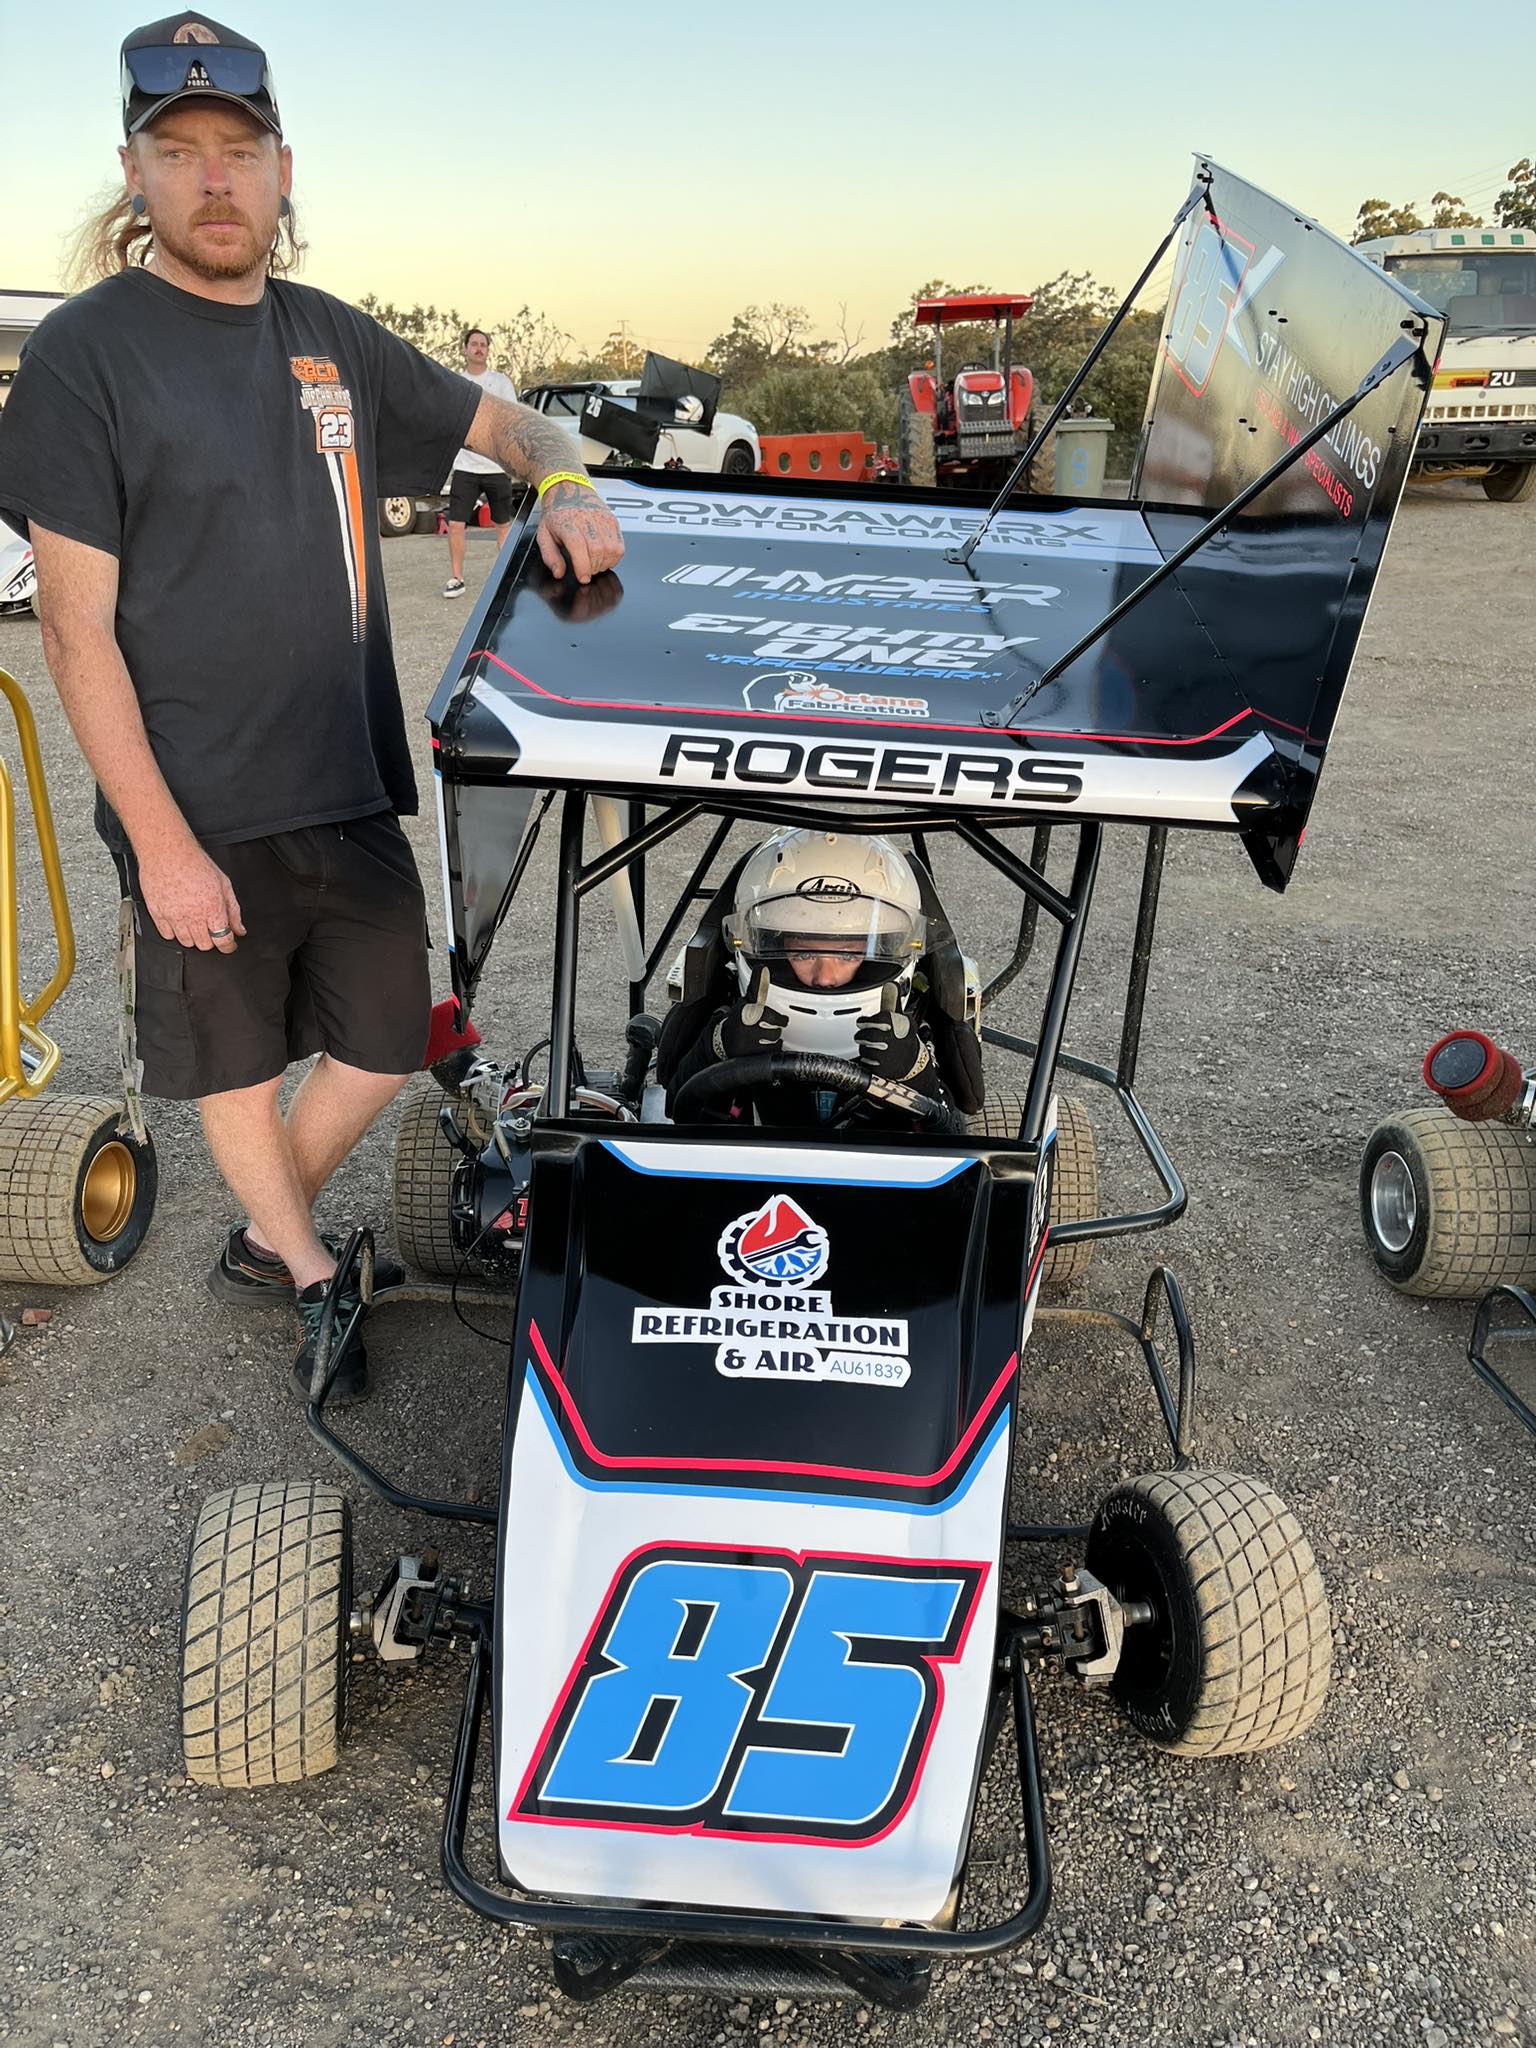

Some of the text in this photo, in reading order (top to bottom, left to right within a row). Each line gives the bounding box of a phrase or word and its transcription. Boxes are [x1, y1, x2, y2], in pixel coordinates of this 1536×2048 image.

[1255, 331, 1292, 388] STAY
[1286, 359, 1321, 423] HIGH
[1489, 371, 1516, 387] ZU
[1304, 448, 1353, 517] SPECIALISTS
[605, 497, 1104, 541] POWDAWERX
[645, 514, 1067, 548] CUSTOM COATING
[710, 565, 1063, 607] HYPER
[731, 591, 993, 614] INDUSTRIES
[668, 613, 1042, 651] EIGHTY
[708, 653, 998, 681] RACEWEAR
[753, 638, 995, 669] ONE
[787, 699, 927, 716] Fabrication
[816, 688, 926, 709] Octane
[659, 734, 1084, 804] ROGERS
[807, 878, 853, 893] Arai
[718, 1291, 825, 1313] SHORE
[639, 1314, 902, 1347] REFRIGERATION
[723, 1348, 816, 1373] & AIR
[829, 1359, 904, 1380] AU61839
[530, 1552, 975, 1832] 85
